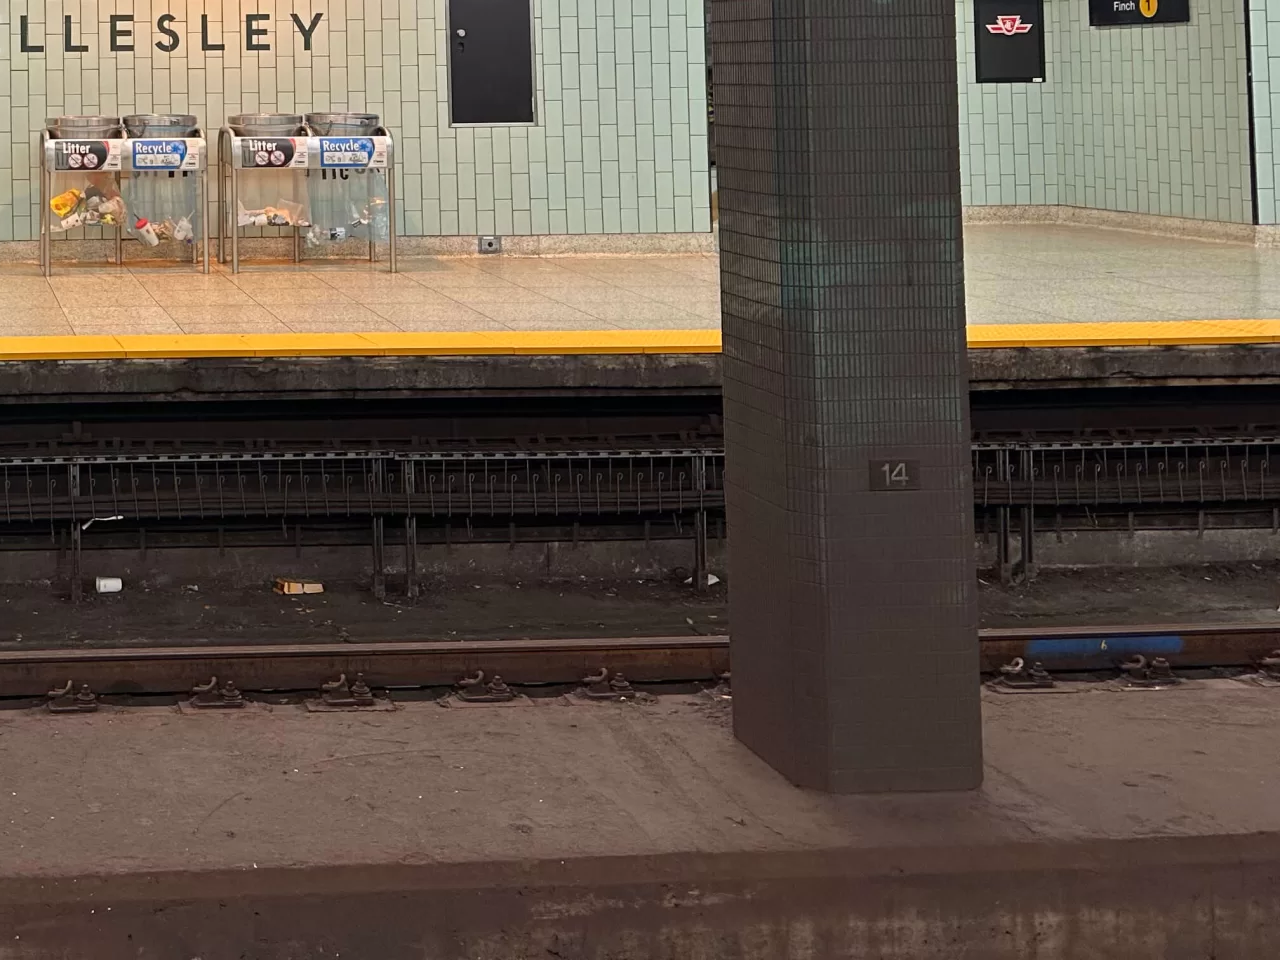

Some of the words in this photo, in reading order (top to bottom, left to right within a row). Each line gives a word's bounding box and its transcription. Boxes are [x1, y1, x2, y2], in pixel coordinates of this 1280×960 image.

[1113, 0, 1136, 11] Finch
[62, 141, 91, 154] Litter
[135, 141, 172, 154] Recycle
[249, 139, 277, 152] Litter
[322, 139, 360, 152] Recycle
[881, 462, 909, 487] 14
